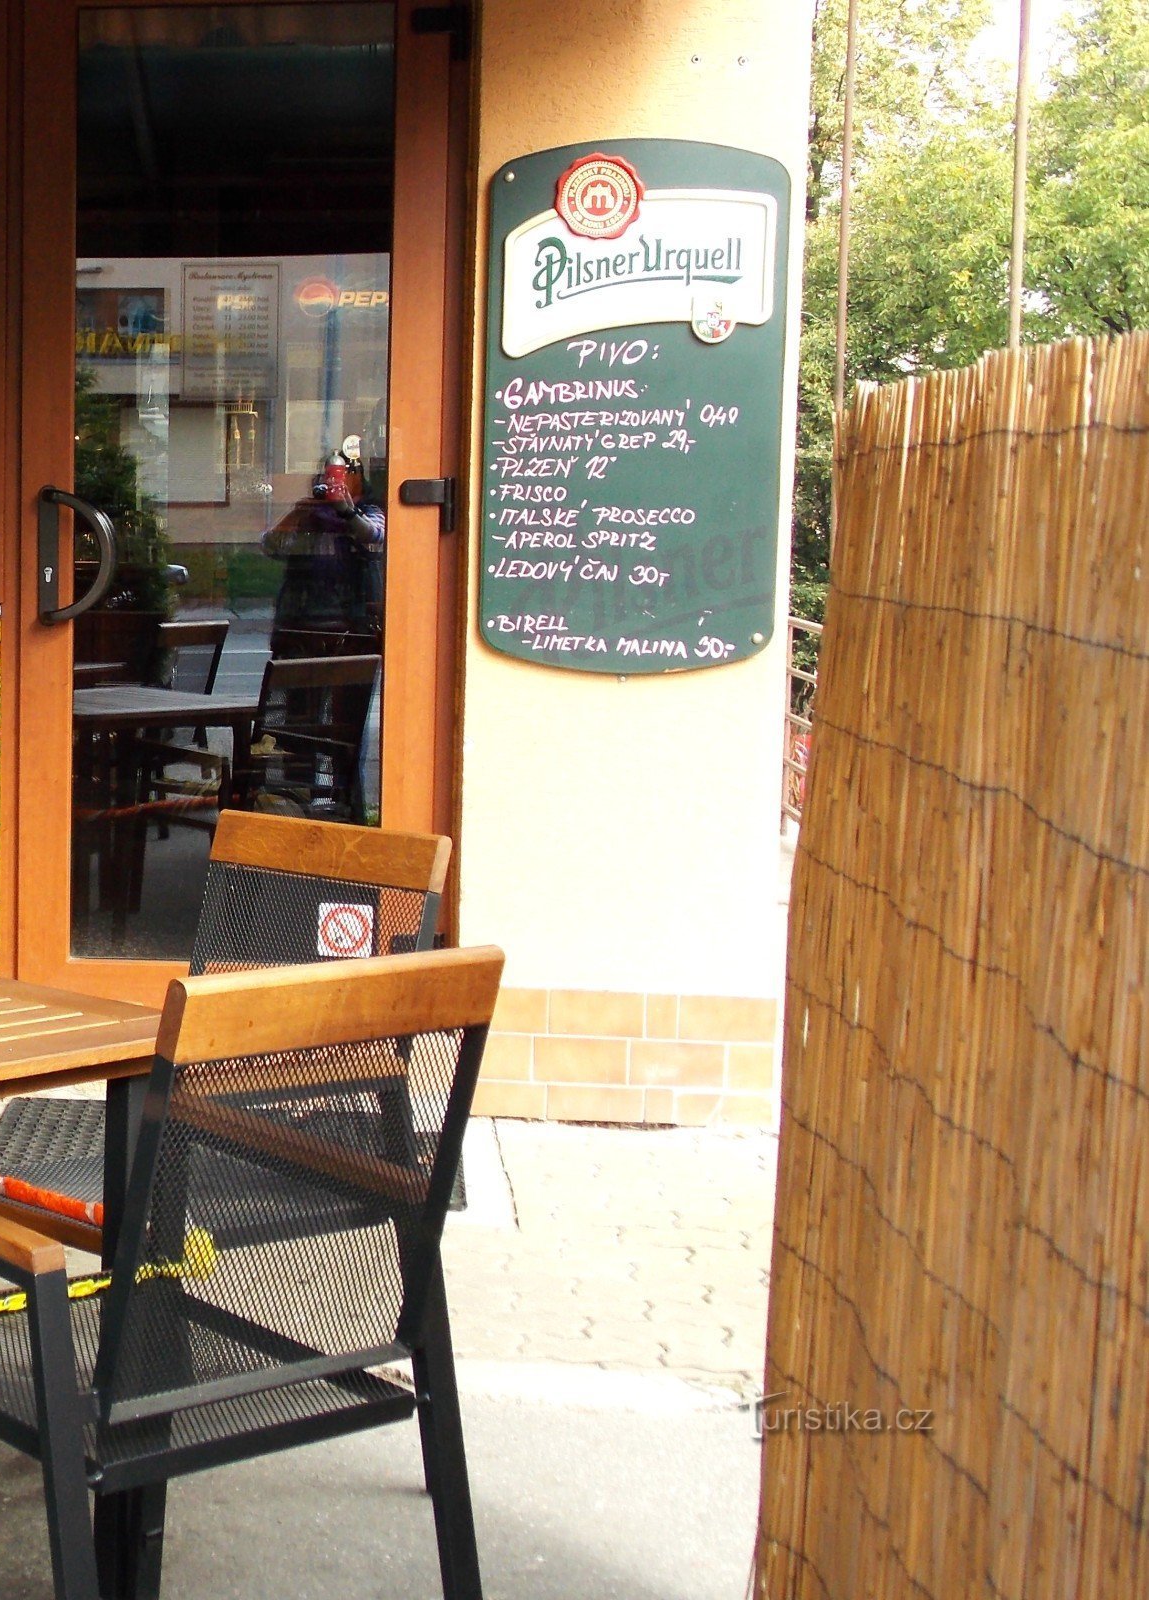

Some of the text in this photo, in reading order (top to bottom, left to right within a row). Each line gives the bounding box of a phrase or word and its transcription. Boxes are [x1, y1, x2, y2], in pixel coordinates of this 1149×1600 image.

[532, 234, 742, 309] Pilsner Urquell
[338, 290, 389, 307] PEP
[567, 340, 660, 368] PIVO:
[600, 432, 656, 449] GREP
[497, 456, 578, 478] PLZEŇ
[500, 484, 567, 503] FRISCO
[499, 499, 696, 527] ITALSKÉ PROSECCO
[582, 530, 658, 551] SPRITZ
[494, 555, 580, 582] LEDOVÝ
[498, 615, 569, 633] BIRELL
[616, 637, 688, 658] MALINA
